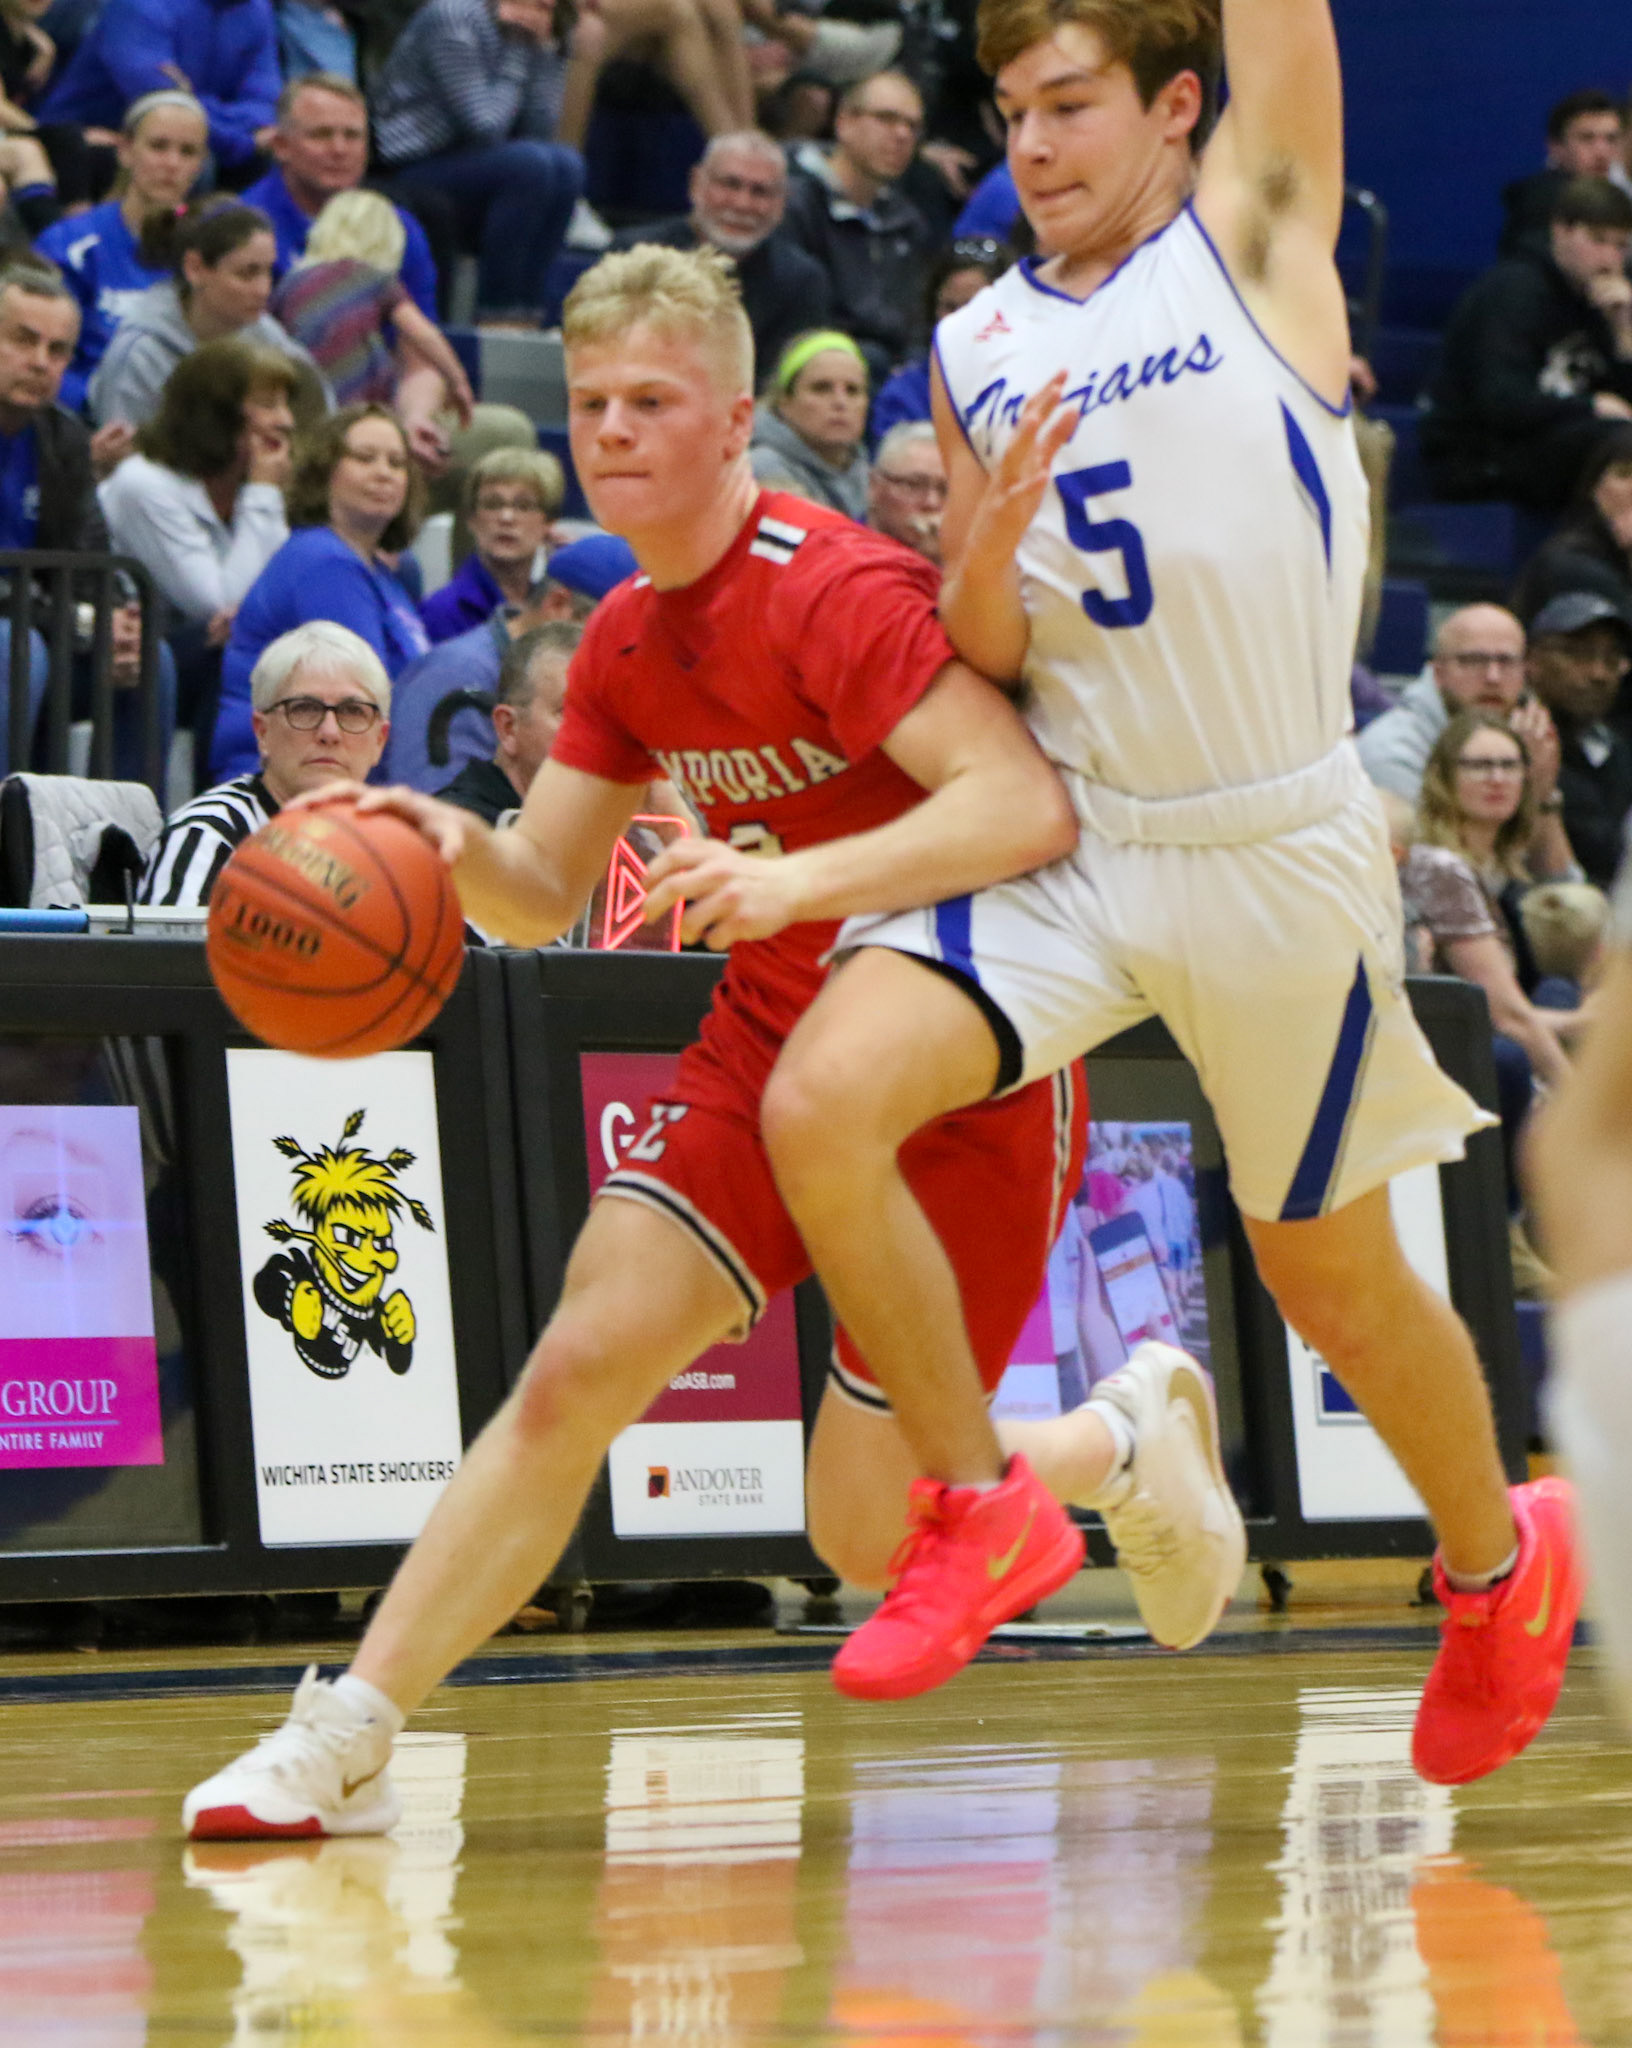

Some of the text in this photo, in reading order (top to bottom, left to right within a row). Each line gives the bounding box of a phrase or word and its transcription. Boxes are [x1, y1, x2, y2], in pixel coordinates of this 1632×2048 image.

[962, 333, 1225, 457] Trjans
[1055, 459, 1154, 630] 5
[322, 1303, 360, 1361] WSU
[1, 1379, 118, 1416] GROUP
[49, 1431, 104, 1449] FAMILY
[262, 1460, 455, 1487] WICHITA STATE SHOCKERS
[673, 1468, 763, 1492] ANDOVER
[698, 1493, 764, 1506] STATE BANK
